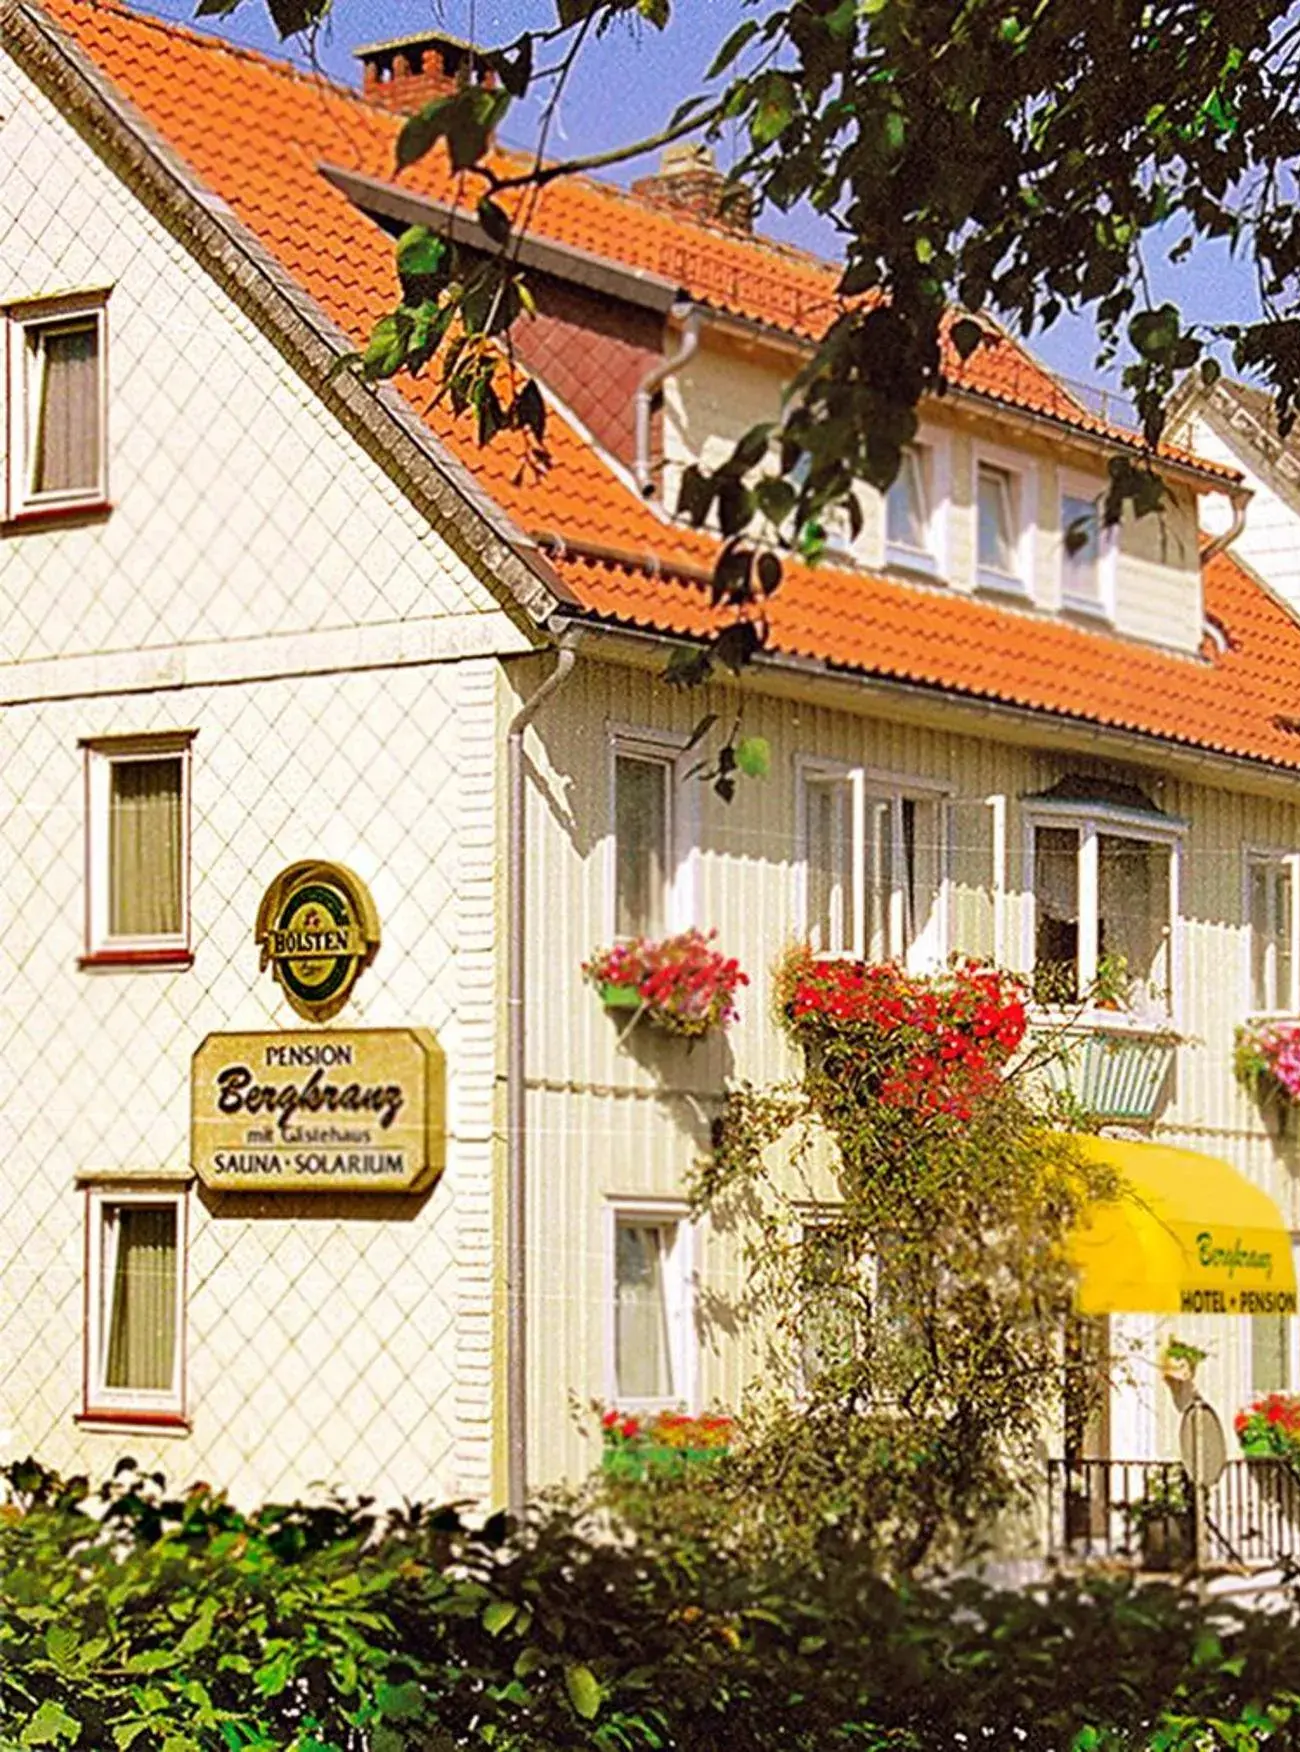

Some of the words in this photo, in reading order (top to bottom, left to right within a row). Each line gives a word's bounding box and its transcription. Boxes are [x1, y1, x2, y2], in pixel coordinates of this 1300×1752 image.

[269, 929, 349, 954] HOLSTEN
[265, 1044, 352, 1067] PENSION
[216, 1066, 404, 1129] Bergkranz
[247, 1127, 273, 1143] mit
[214, 1155, 283, 1174] SAUNA
[295, 1152, 404, 1174] SOLARIUM
[1181, 1289, 1227, 1313] HOTEL
[1239, 1290, 1297, 1313] PENSION
